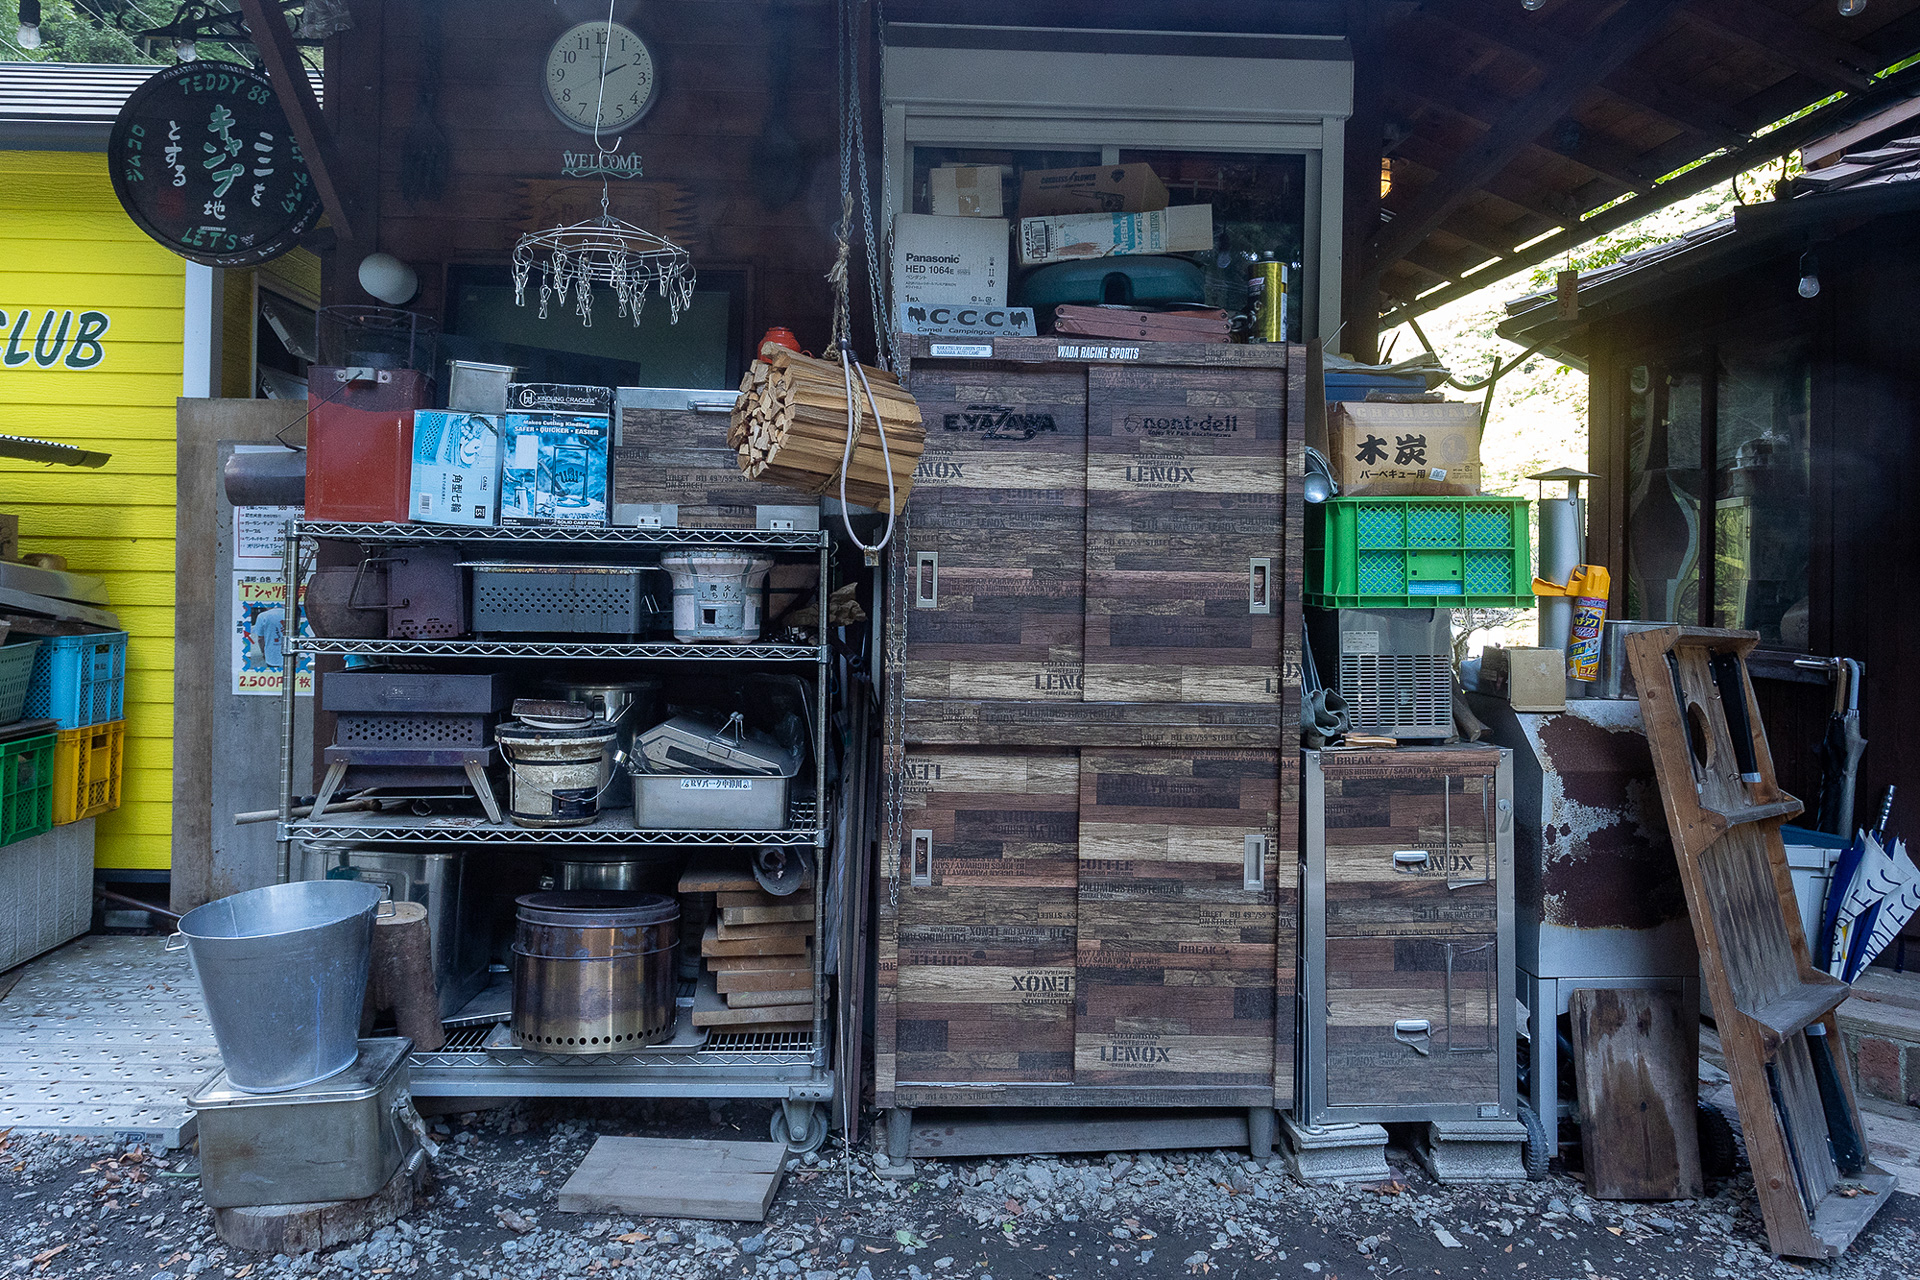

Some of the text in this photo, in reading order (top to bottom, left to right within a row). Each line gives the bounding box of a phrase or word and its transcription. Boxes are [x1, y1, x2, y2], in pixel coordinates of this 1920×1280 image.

[577, 37, 590, 50] 11
[620, 39, 626, 51] 1
[562, 51, 577, 63] 10
[632, 53, 642, 66] 2
[556, 68, 565, 83] 9
[637, 72, 647, 86] 3
[178, 73, 271, 104] TEDDY 88
[562, 88, 572, 102] 8
[630, 91, 639, 104] 4
[578, 102, 588, 116] 7
[616, 104, 624, 118] 5
[164, 120, 187, 187] とする
[203, 104, 245, 221] キャンプ地
[562, 153, 643, 169] WELCOME
[251, 131, 275, 207] ここを
[180, 227, 238, 250] LET'S
[905, 252, 960, 264] Panasonic
[905, 265, 926, 275] HED
[948, 327, 997, 336] Campingcar
[1057, 345, 1079, 358] WADA
[1080, 346, 1108, 359] RACING
[1109, 348, 1140, 360] SPORTS
[1355, 433, 1428, 466] 木炭
[1125, 465, 1196, 483] LENOX
[1360, 469, 1426, 479] バーベキュー用
[702, 591, 739, 599] しちりん
[1336, 756, 1372, 765] BREAK
[1180, 945, 1216, 954] BREAK
[1100, 1046, 1172, 1062] LENOX
